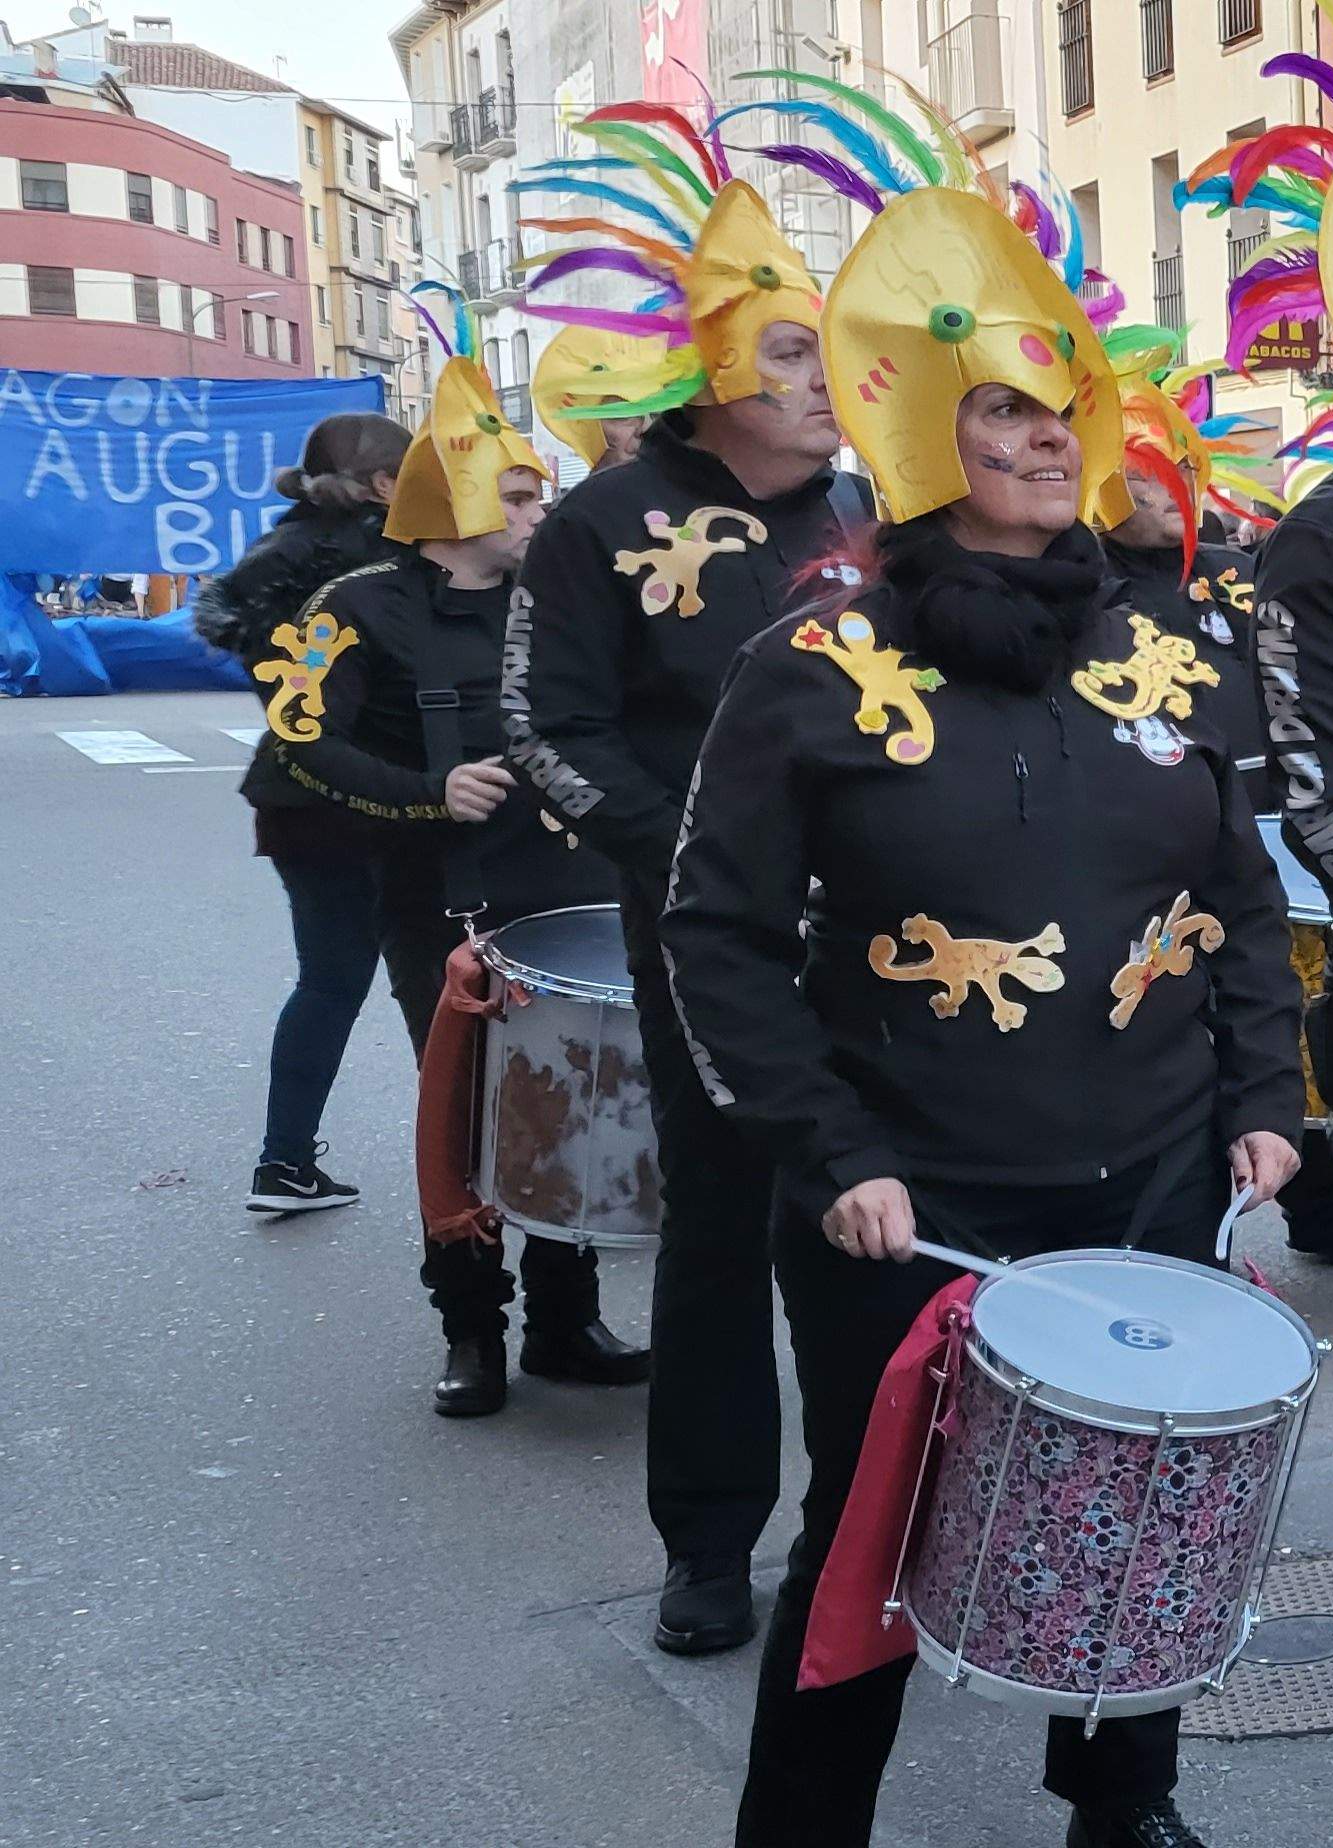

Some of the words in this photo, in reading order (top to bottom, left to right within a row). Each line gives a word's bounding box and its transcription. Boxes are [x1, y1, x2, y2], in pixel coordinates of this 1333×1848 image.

[1249, 344, 1312, 359] ABACOS
[26, 428, 277, 503] AUGU
[1256, 600, 1317, 743] DRUMS
